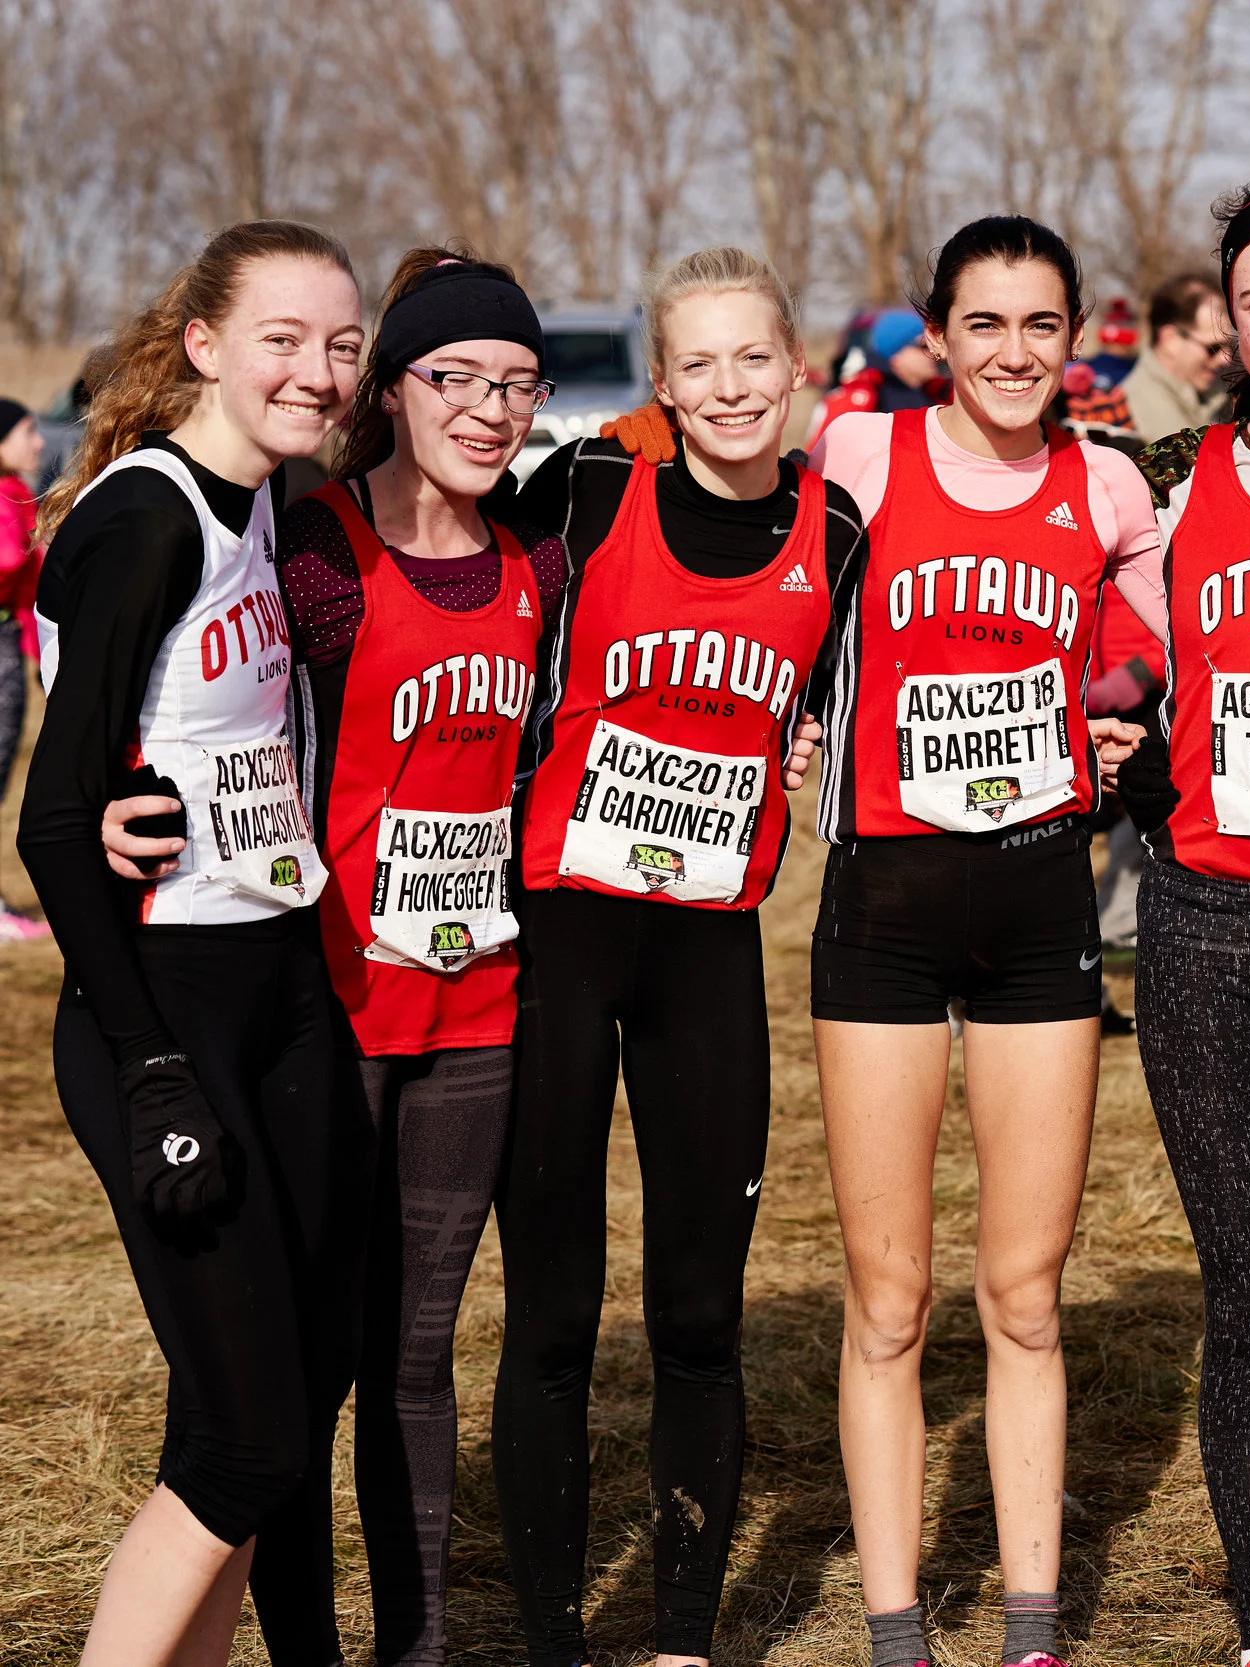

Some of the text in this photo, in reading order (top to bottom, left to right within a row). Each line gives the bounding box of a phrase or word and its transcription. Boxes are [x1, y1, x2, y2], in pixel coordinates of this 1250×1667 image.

[1045, 514, 1079, 531] adidas
[779, 582, 813, 593] adidas
[888, 555, 1079, 652] OTTAWA
[945, 623, 1024, 645] LIONS
[257, 657, 288, 683] LIONS
[604, 628, 796, 721] OTTAWA
[391, 652, 536, 743] OTTAWA
[657, 694, 737, 718] LIONS
[906, 670, 1055, 722] ACXC2018
[437, 725, 498, 742] LIONS
[902, 730, 911, 779] 1535
[923, 720, 1049, 774] BARRETT
[1058, 709, 1068, 757] 1535
[1214, 725, 1223, 774] 1568
[597, 734, 758, 802] ACXC2018
[575, 772, 593, 820] 1540
[599, 785, 736, 847] GARDINER
[741, 808, 756, 853] 1540
[374, 864, 386, 914] 1542
[398, 869, 495, 913] HONEGGER
